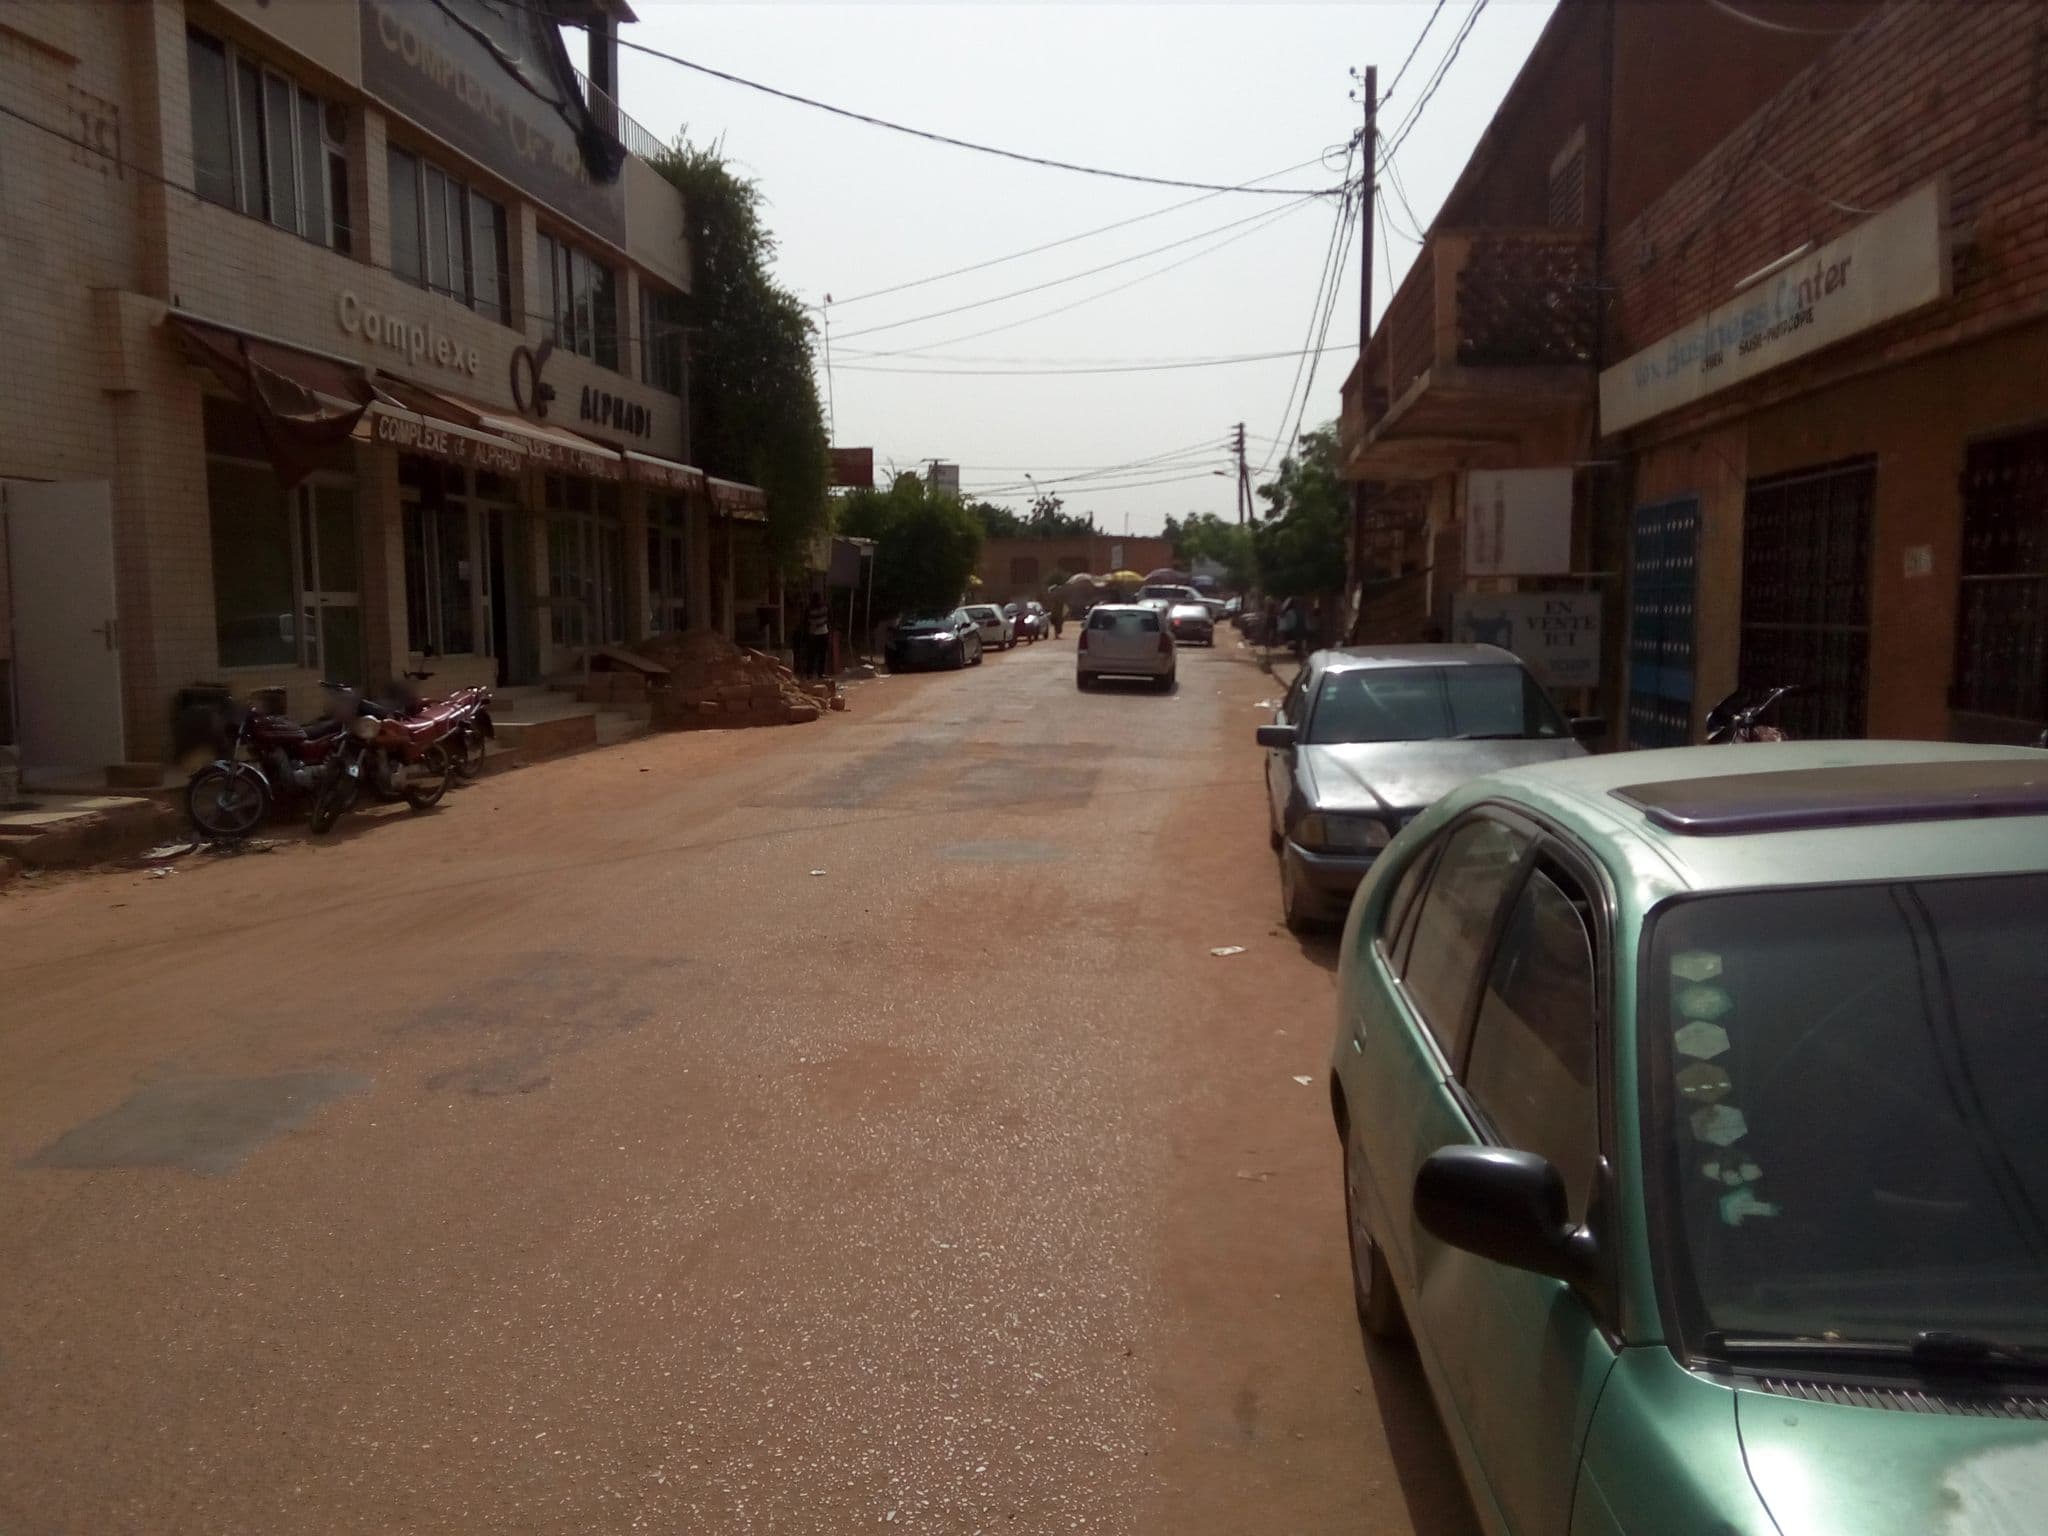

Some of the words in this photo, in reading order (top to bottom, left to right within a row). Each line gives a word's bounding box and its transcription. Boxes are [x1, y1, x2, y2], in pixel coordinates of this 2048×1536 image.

[339, 288, 481, 373] Complexe
[580, 384, 652, 439] ALPHADI
[378, 414, 448, 454] COMPLEXE
[1545, 600, 1573, 615] EN
[1527, 615, 1598, 631] VENTE
[1545, 631, 1576, 647] ICI
